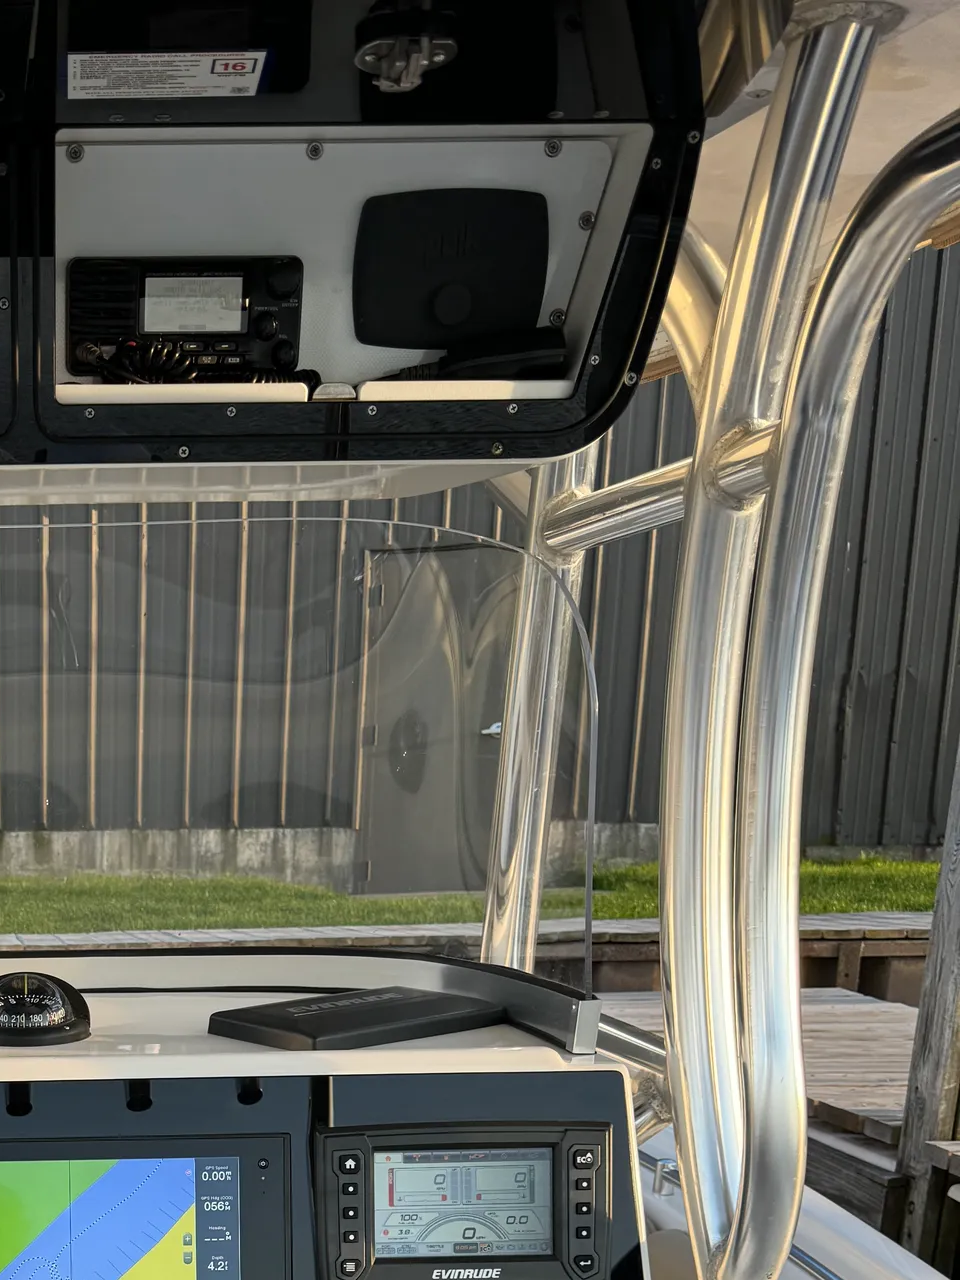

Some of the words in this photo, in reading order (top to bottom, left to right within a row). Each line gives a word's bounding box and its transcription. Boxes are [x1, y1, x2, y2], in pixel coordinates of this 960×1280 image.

[220, 62, 247, 71] 16
[286, 992, 404, 1013] EVINRUDE
[11, 1015, 25, 1023] 210
[30, 1014, 43, 1022] 180
[577, 1153, 594, 1164] ECO
[202, 1171, 226, 1181] 0.00
[204, 1201, 224, 1212] 056
[400, 1214, 419, 1222] 100
[506, 1215, 529, 1225] 0.0
[462, 1227, 476, 1240] 0
[207, 1261, 225, 1271] 4.2
[432, 1268, 502, 1280] EVINRUDE
